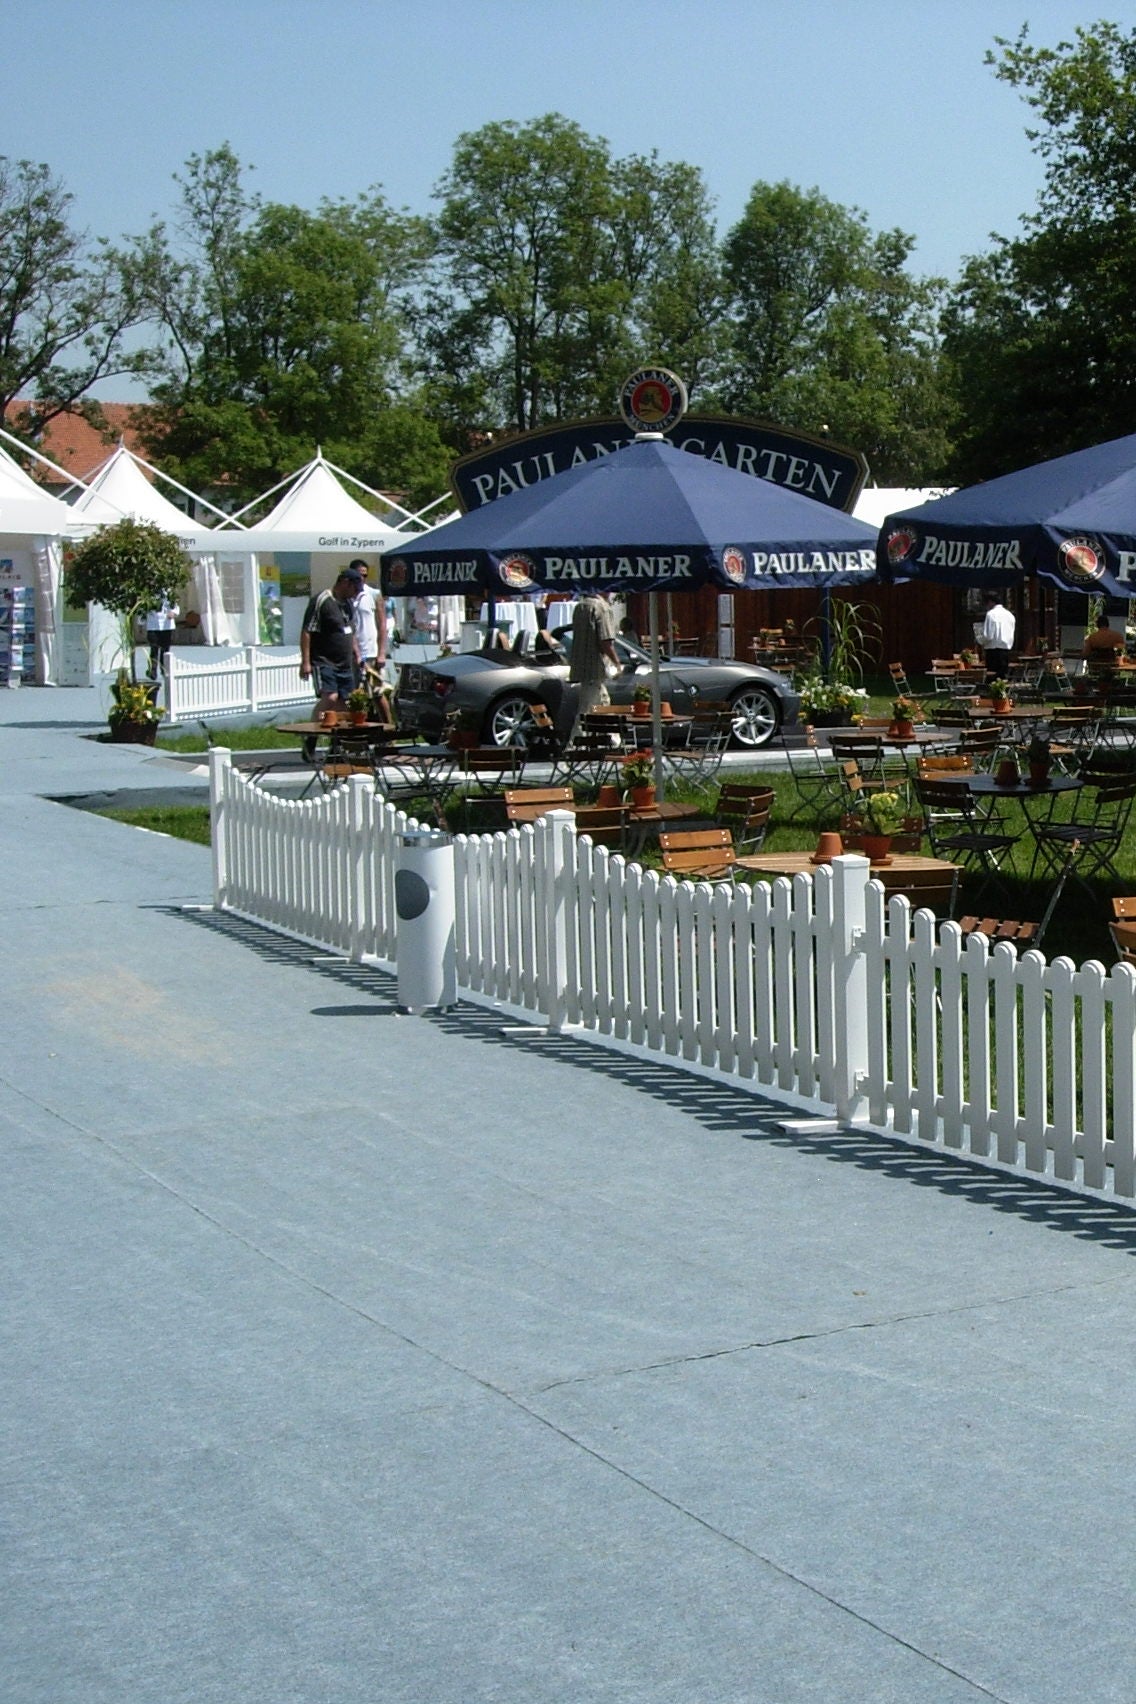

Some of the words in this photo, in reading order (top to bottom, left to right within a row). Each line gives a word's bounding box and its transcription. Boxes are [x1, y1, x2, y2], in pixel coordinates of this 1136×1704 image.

[624, 371, 679, 397] PAULANER
[470, 438, 843, 506] PAULANGARTEN
[318, 537, 338, 546] Golf
[340, 537, 350, 546] in
[350, 538, 385, 549] Zypern
[916, 535, 1024, 569] PAULANER
[544, 554, 693, 580] PAULANER
[753, 549, 878, 576] PAULANER
